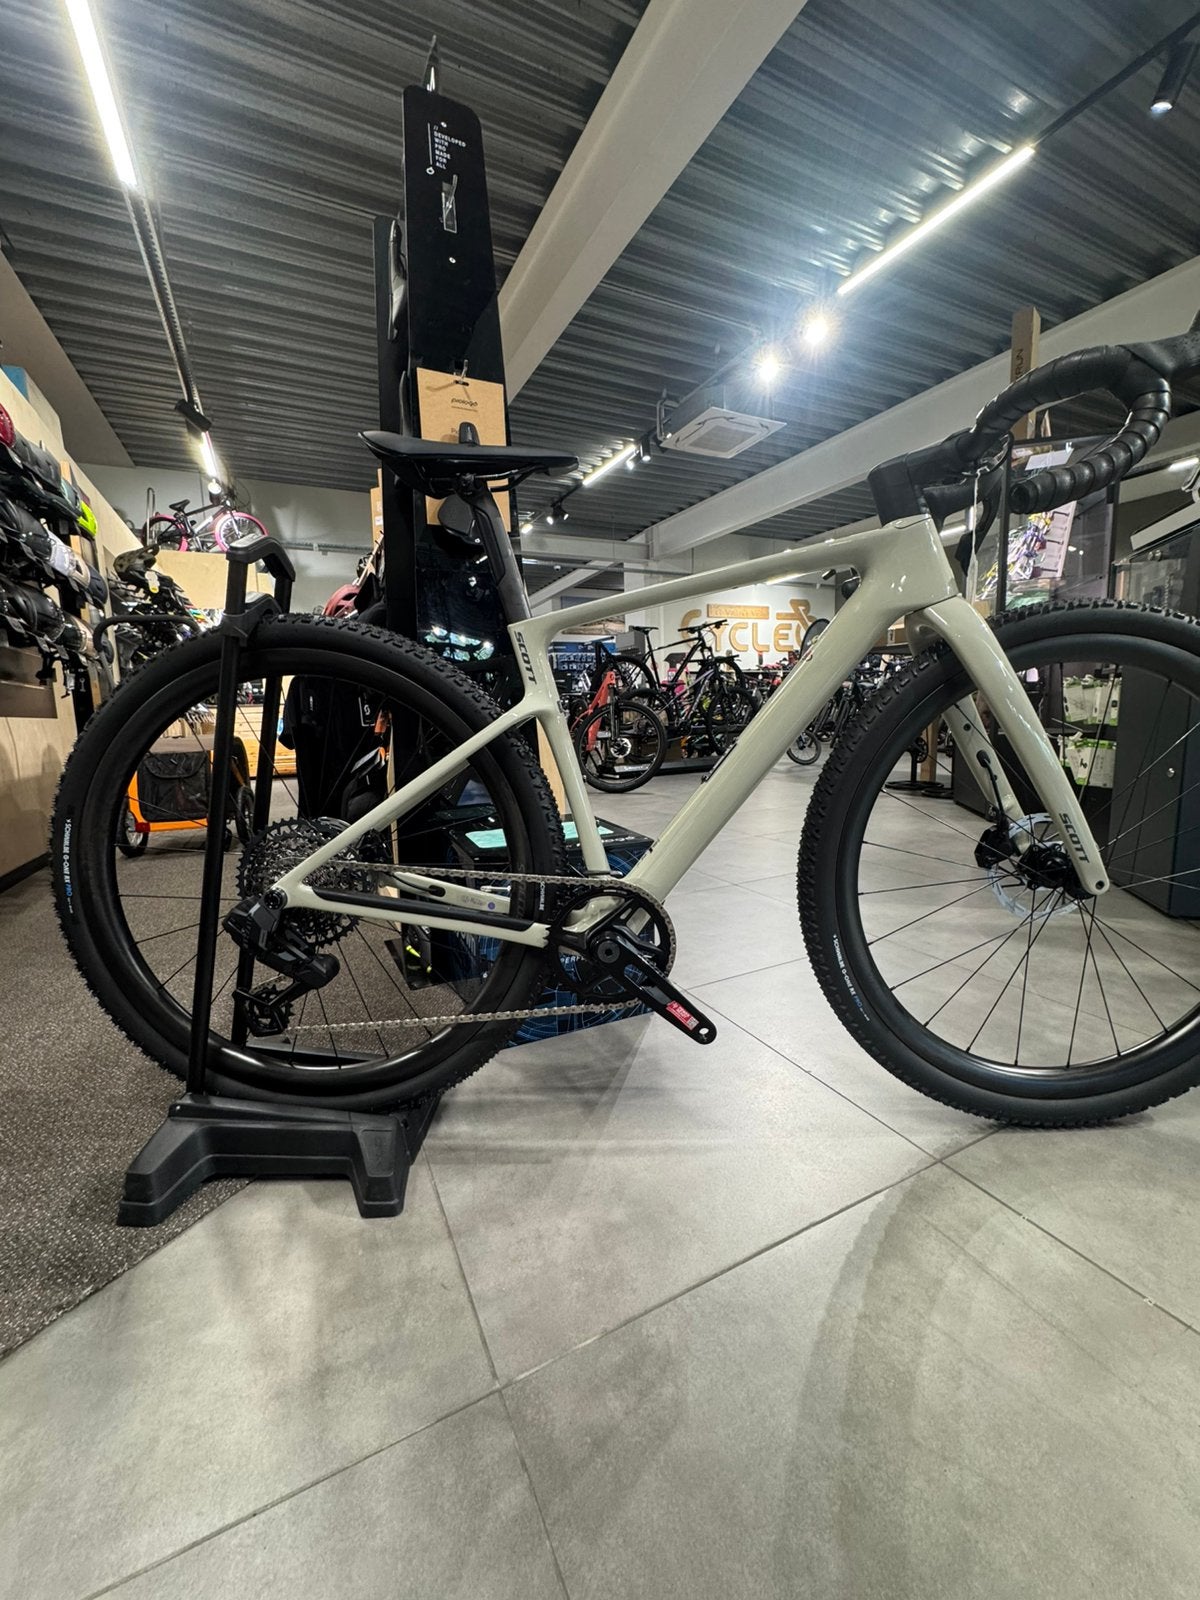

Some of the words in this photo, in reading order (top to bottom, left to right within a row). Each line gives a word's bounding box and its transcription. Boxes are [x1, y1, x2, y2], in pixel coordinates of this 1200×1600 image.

[433, 131, 466, 148] DEVELOPED
[434, 137, 449, 147] WITH
[435, 149, 451, 160] MADE
[435, 155, 447, 164] FOR
[436, 161, 447, 170] ALL
[513, 630, 538, 686] SCOTT
[1058, 812, 1090, 864] SCOTT
